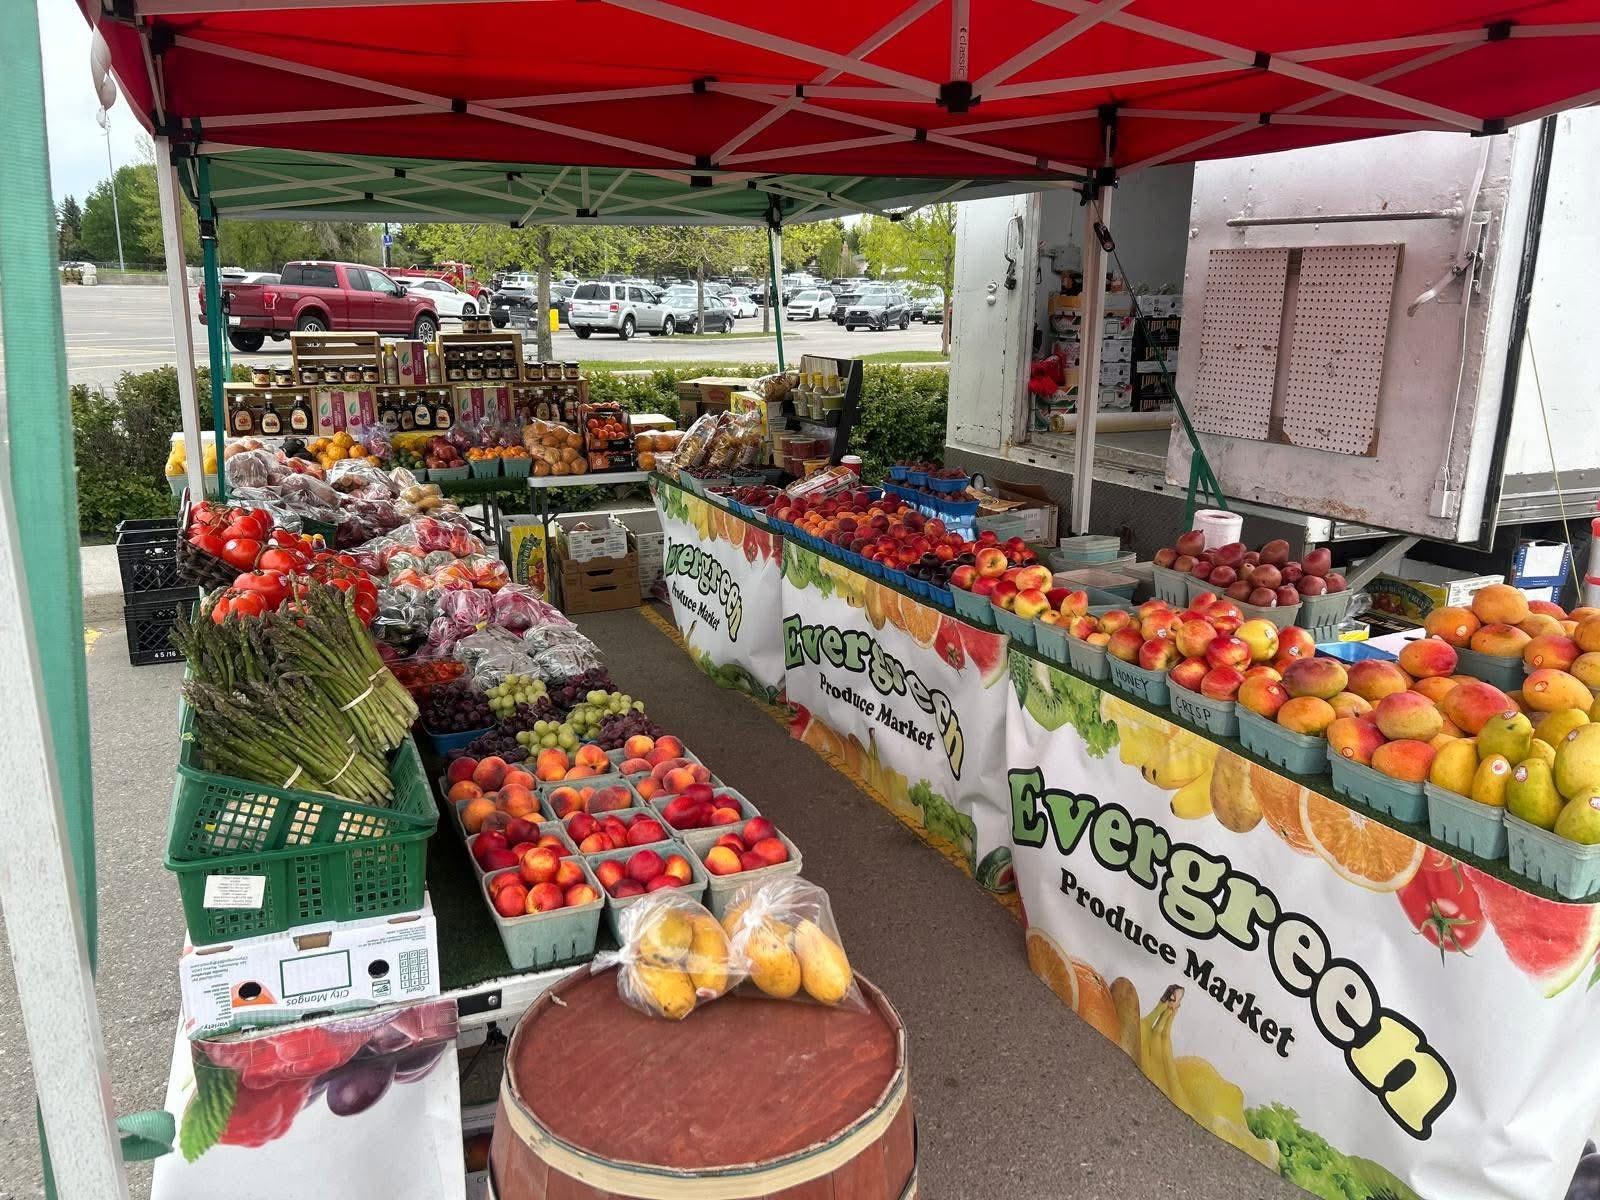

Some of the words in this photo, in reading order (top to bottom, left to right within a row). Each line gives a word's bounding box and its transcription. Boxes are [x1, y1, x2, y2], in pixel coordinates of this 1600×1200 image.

[959, 36, 967, 77] classic
[697, 602, 720, 631] Market
[1115, 667, 1149, 692] HONEY
[783, 613, 965, 781] Evergreen
[819, 672, 875, 716] Produce
[875, 703, 936, 750] Market
[1175, 696, 1211, 721] CRISP
[1008, 765, 1457, 1142] Evergreen
[1060, 868, 1177, 966] Produce
[1183, 948, 1296, 1059] Market
[286, 993, 328, 1007] Mangos
[330, 989, 350, 999] City
[203, 1021, 229, 1030] Variety
